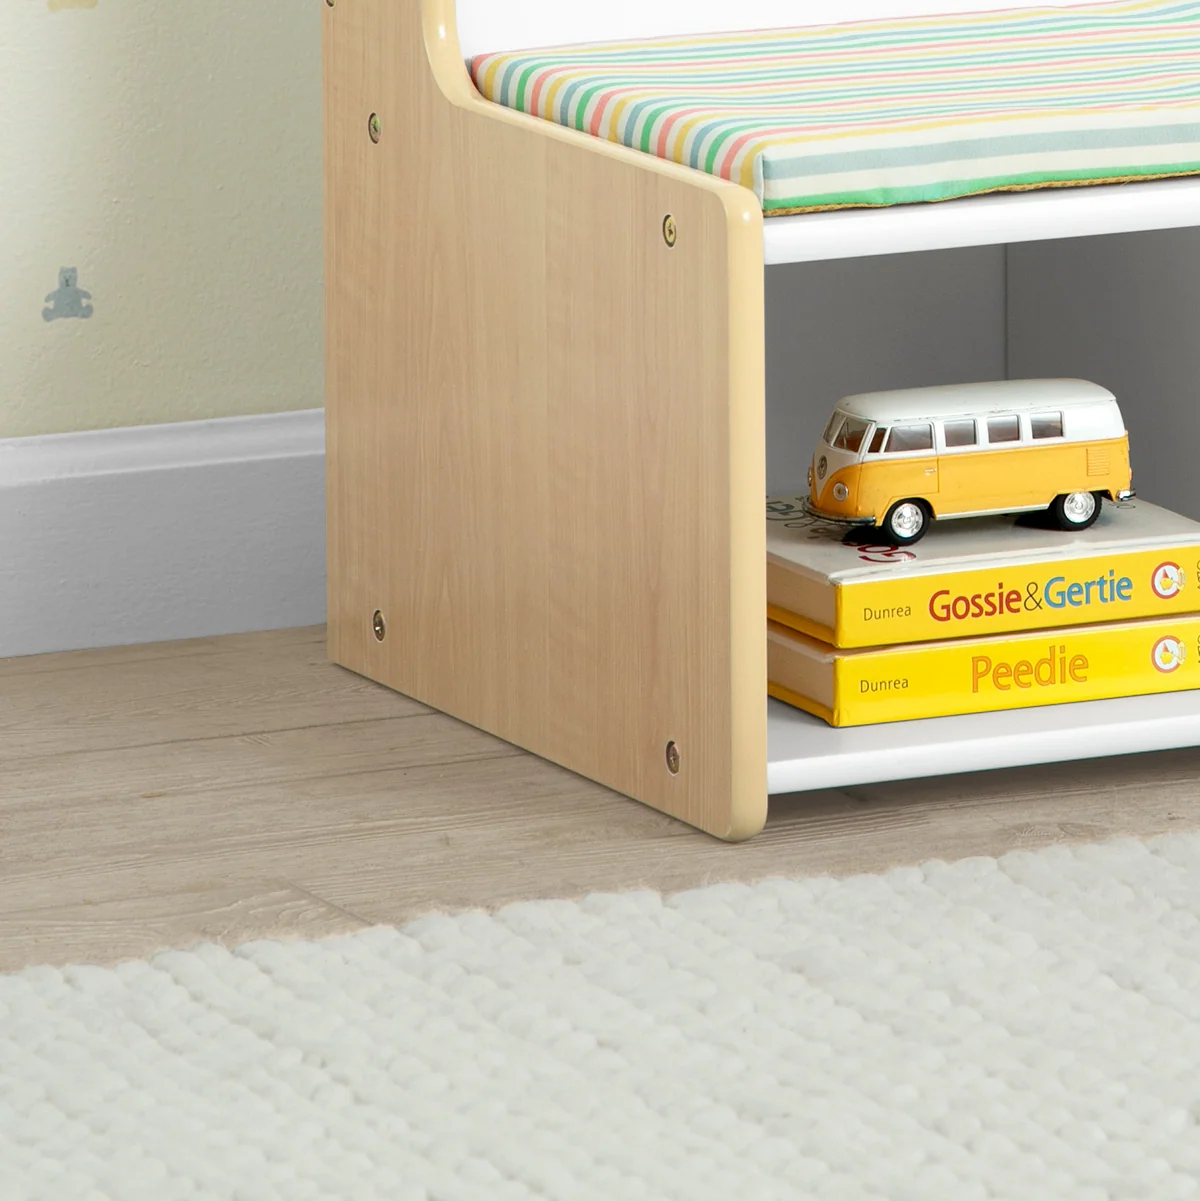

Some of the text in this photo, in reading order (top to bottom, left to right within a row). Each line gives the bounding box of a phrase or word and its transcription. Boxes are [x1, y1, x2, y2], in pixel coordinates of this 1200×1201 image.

[863, 605, 912, 622] Dunrea
[860, 677, 909, 694] Dunrea
[971, 644, 1089, 694] Peedie
